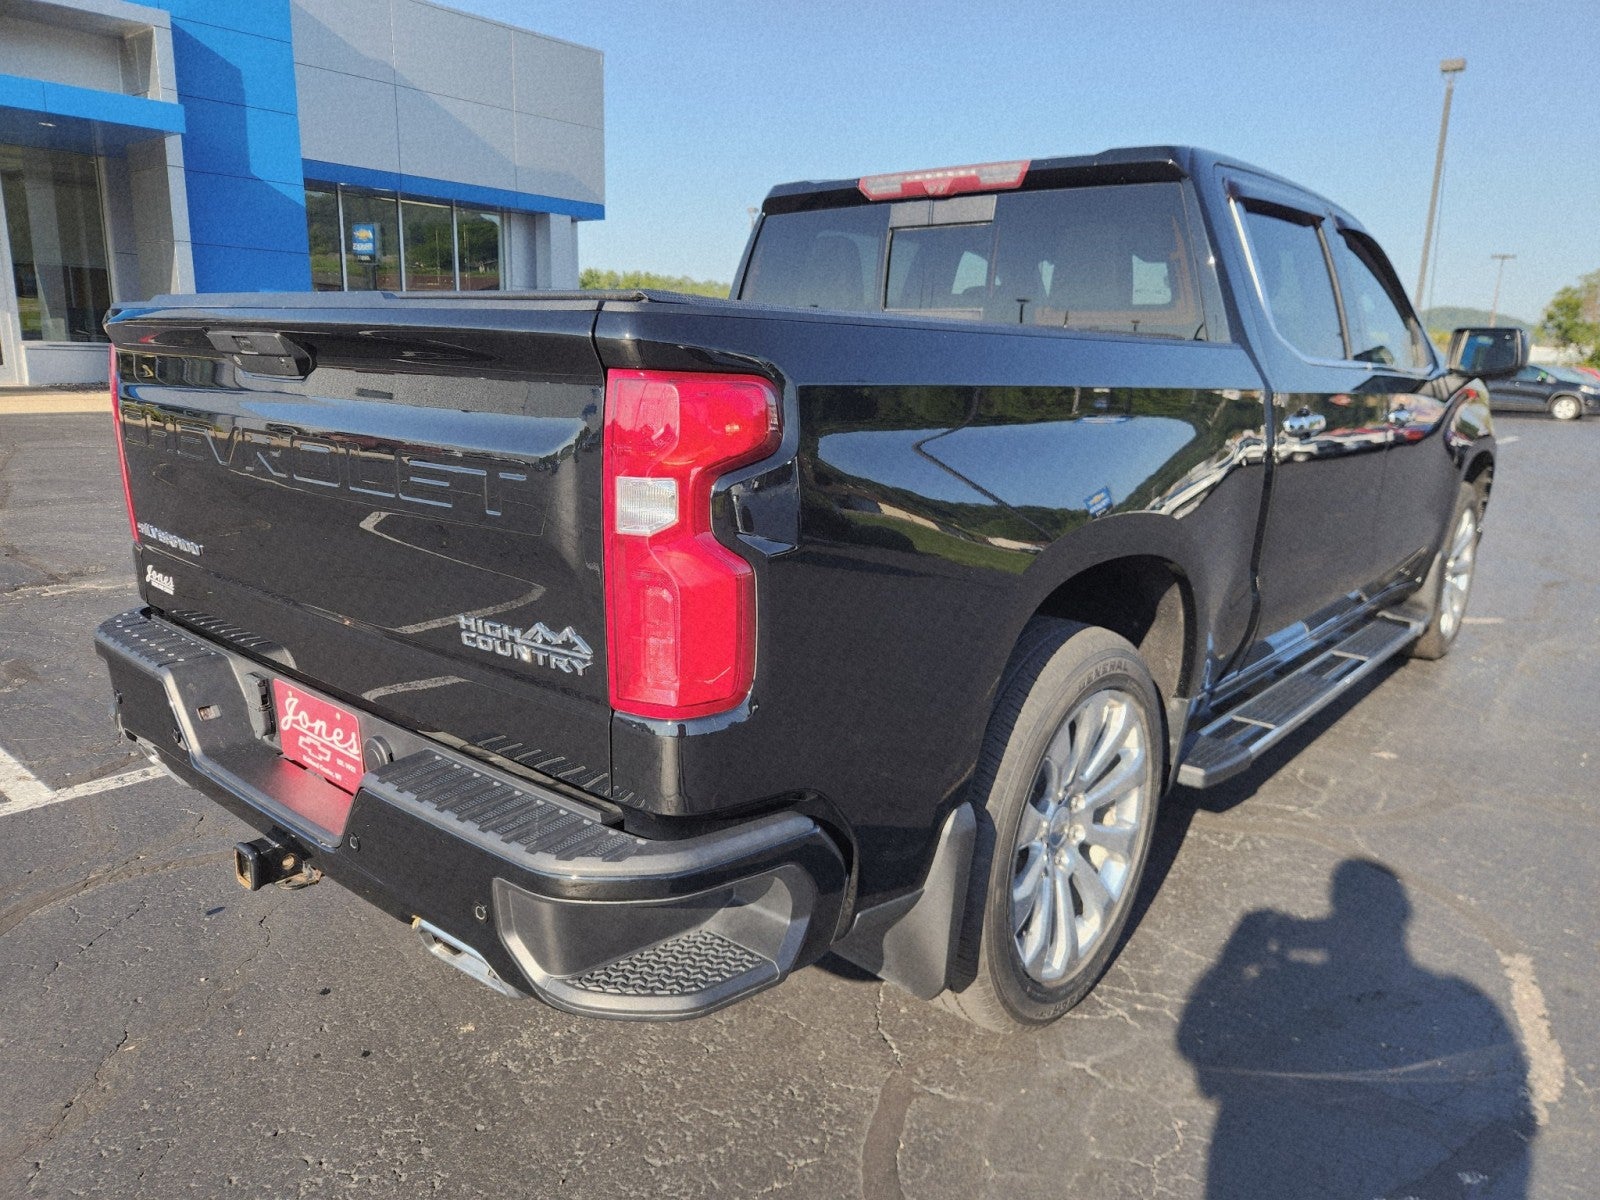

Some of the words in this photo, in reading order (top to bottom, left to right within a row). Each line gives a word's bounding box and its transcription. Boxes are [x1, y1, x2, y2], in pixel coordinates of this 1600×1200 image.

[459, 612, 521, 642] HIGH
[461, 630, 593, 677] COUNTRY
[281, 697, 360, 755] Jones
